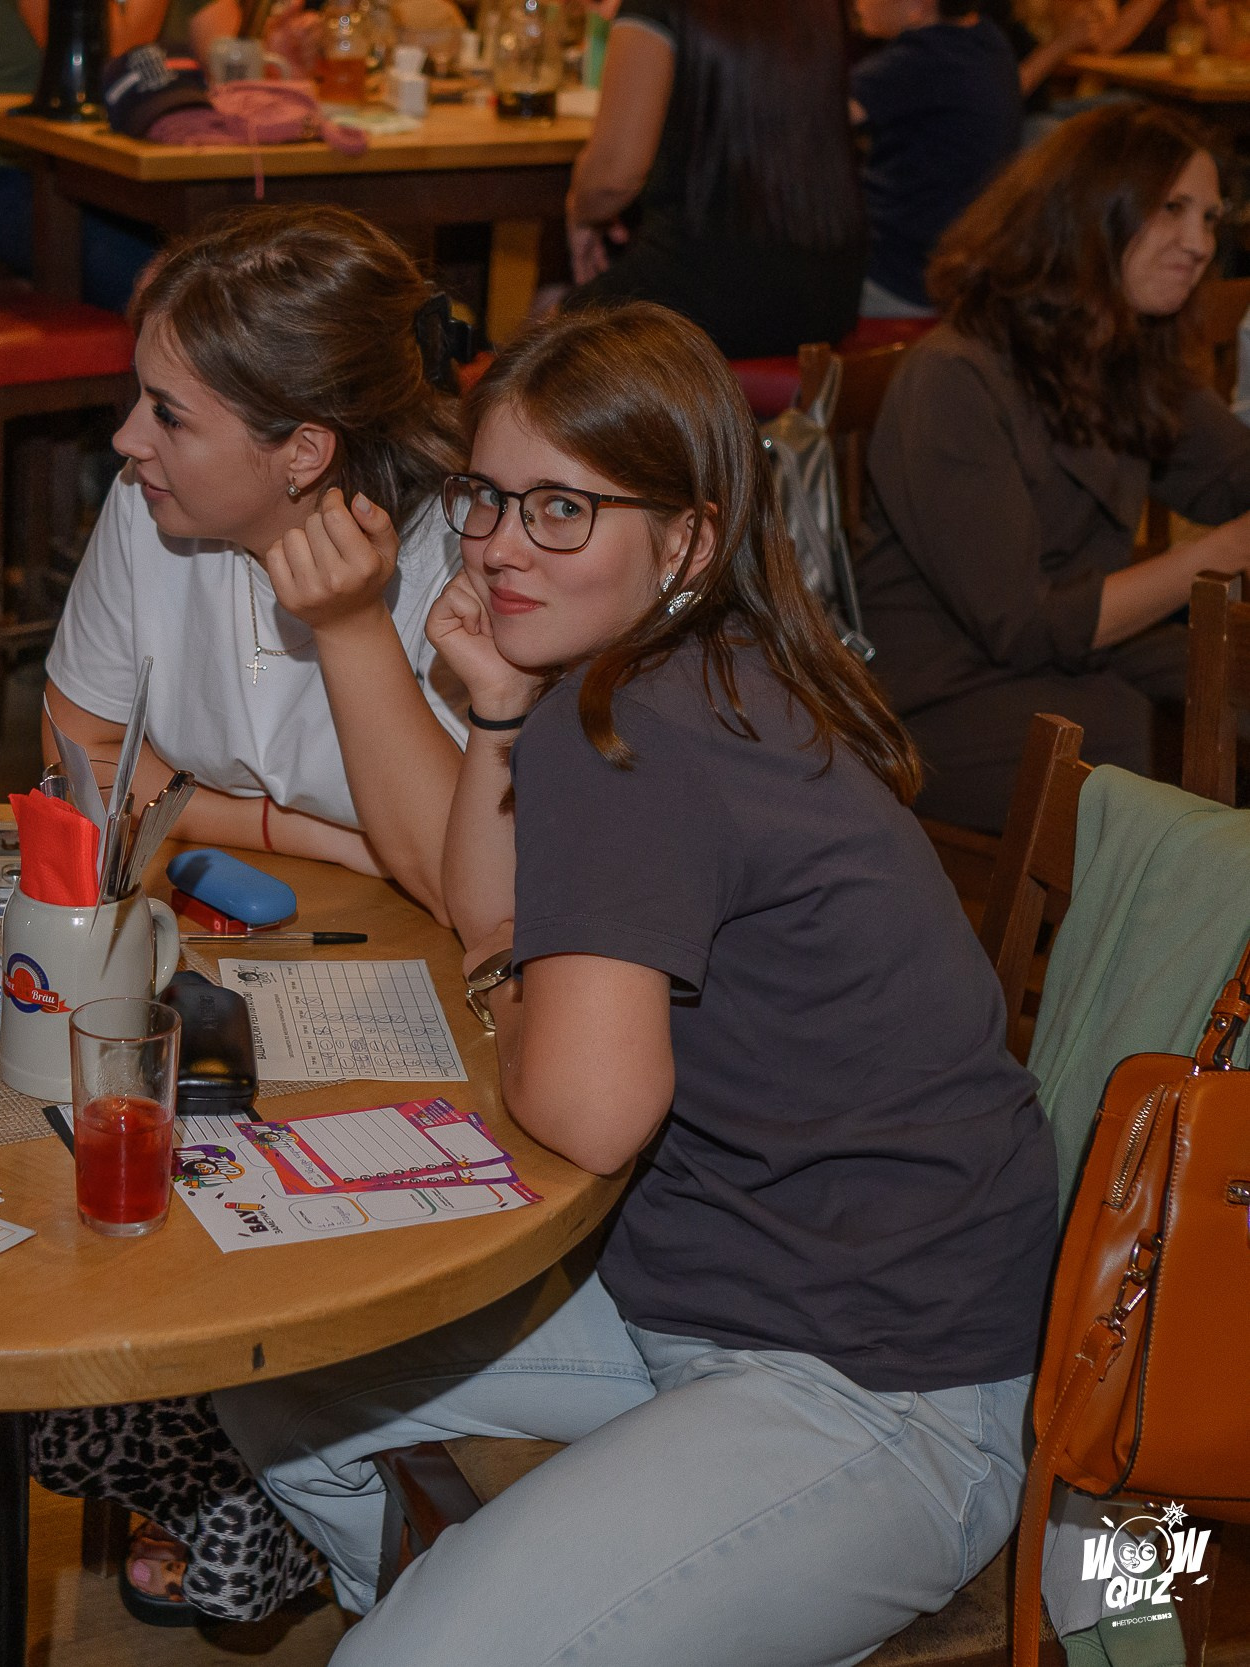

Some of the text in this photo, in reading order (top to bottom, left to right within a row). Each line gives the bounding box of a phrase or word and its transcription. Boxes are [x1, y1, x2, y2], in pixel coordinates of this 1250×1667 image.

[31, 989, 55, 1003] Bräu
[206, 1153, 243, 1176] QUIZ
[233, 1206, 270, 1234] ВАУ
